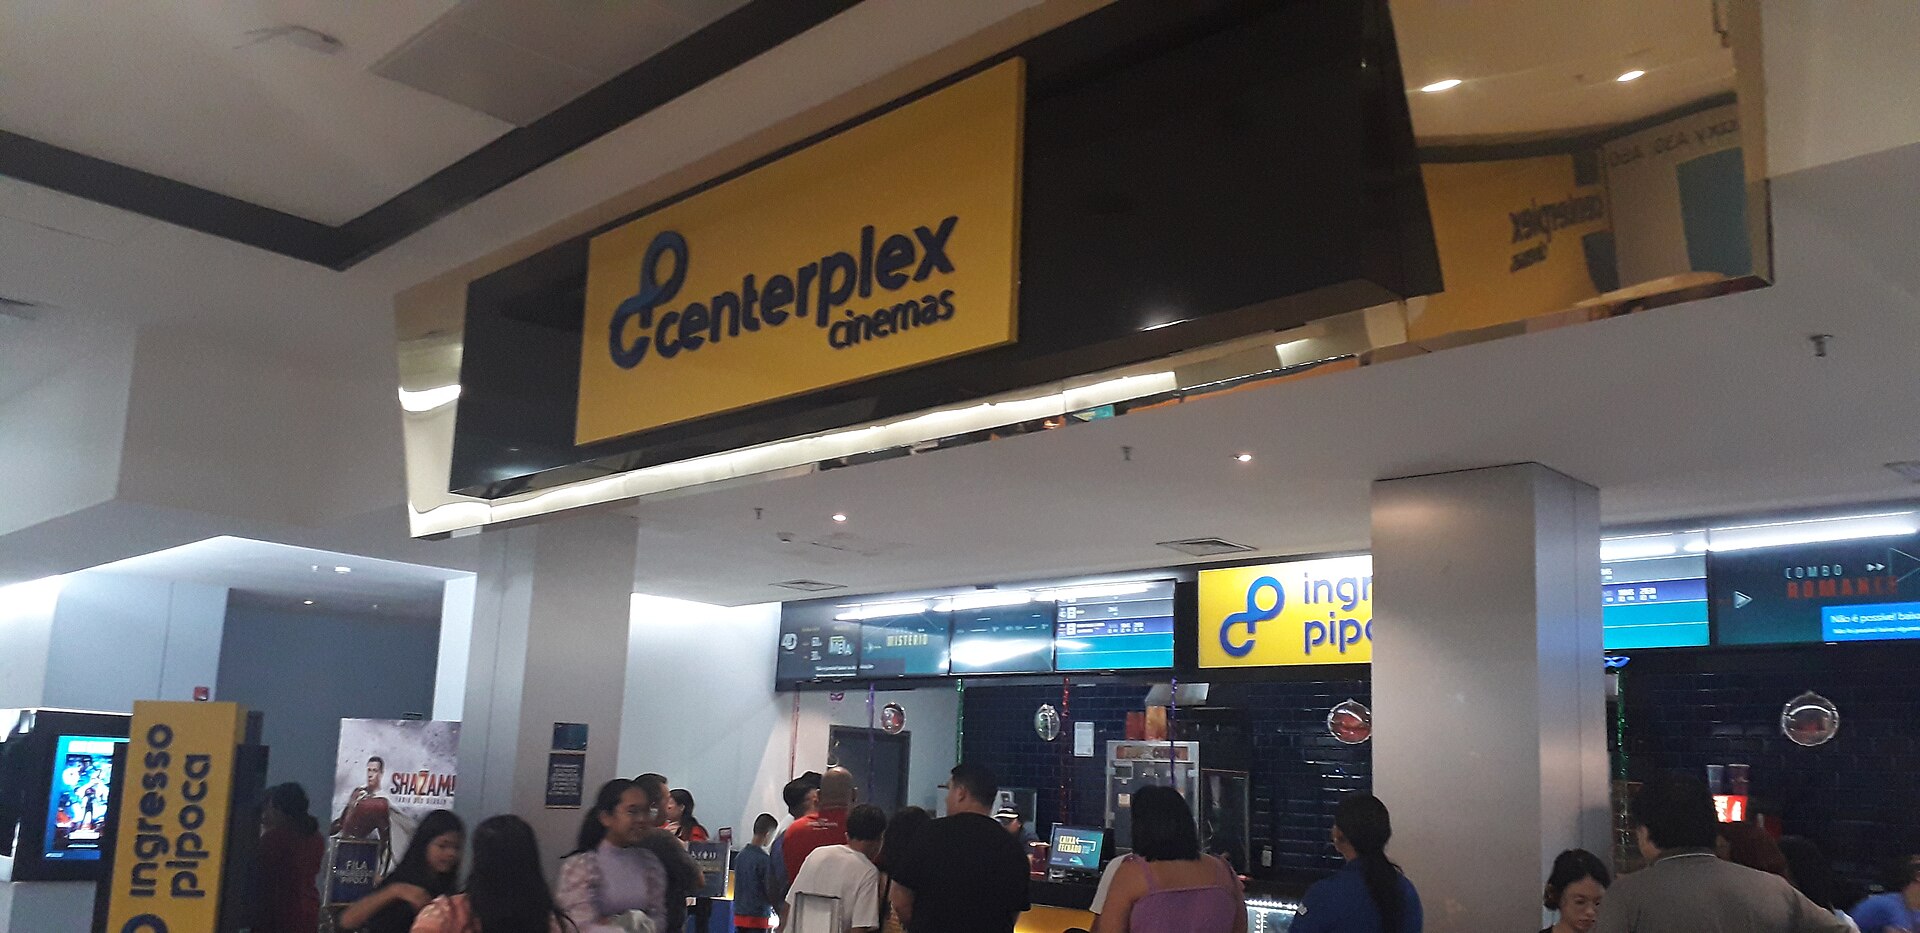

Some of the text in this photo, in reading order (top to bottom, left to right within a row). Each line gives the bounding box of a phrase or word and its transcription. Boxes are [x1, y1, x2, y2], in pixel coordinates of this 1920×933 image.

[654, 215, 959, 359] centerplex
[828, 289, 955, 350] cinemas
[1785, 564, 1842, 579] COMBO
[129, 723, 174, 897] ingresso
[165, 753, 212, 900] pipoca
